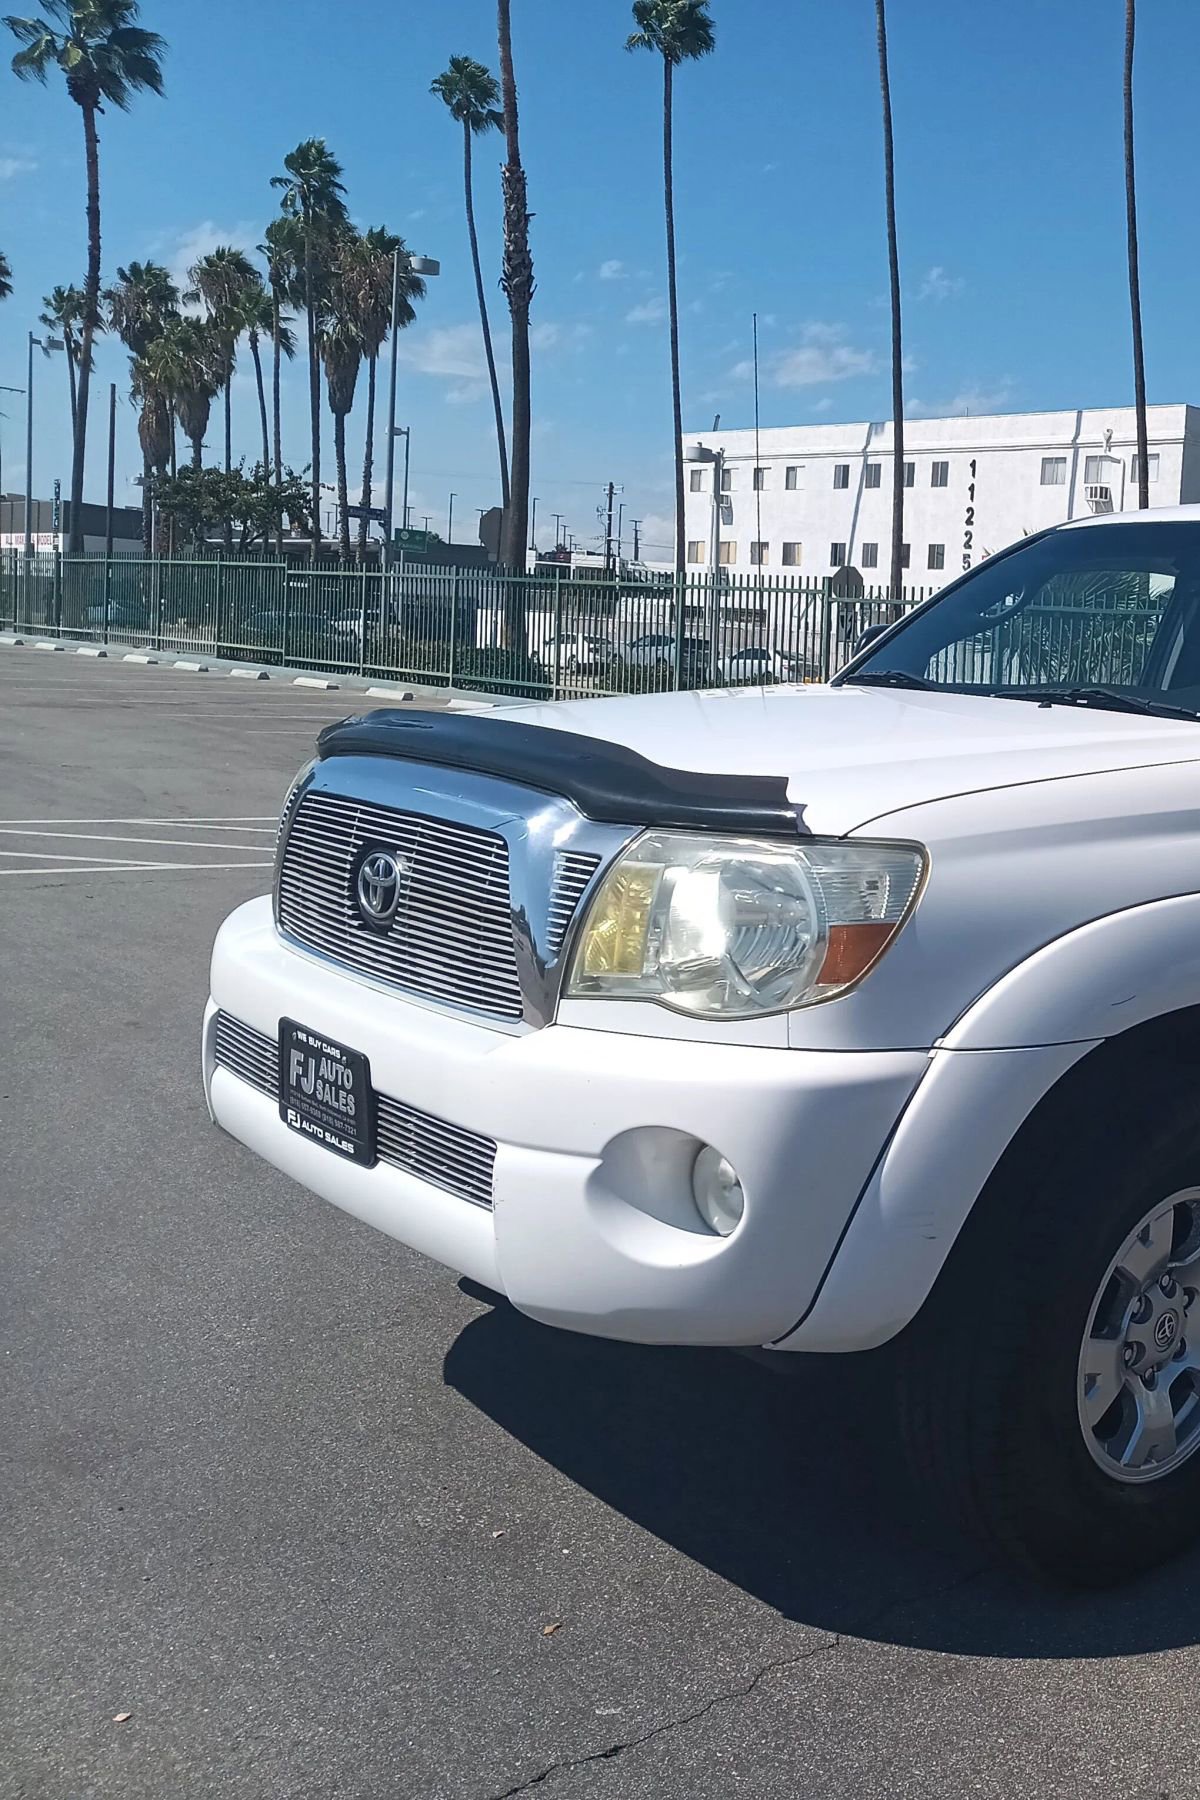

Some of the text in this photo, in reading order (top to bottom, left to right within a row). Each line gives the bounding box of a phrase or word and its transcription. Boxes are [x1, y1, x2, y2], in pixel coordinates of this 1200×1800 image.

[962, 459, 976, 571] 11225
[297, 1030, 341, 1059] WE BUY CARS
[290, 1048, 353, 1095] FJ AUTO
[316, 1079, 355, 1116] SALES
[287, 1108, 301, 1129] FJ
[302, 1120, 323, 1139] AUTO
[325, 1132, 355, 1154] SALES
